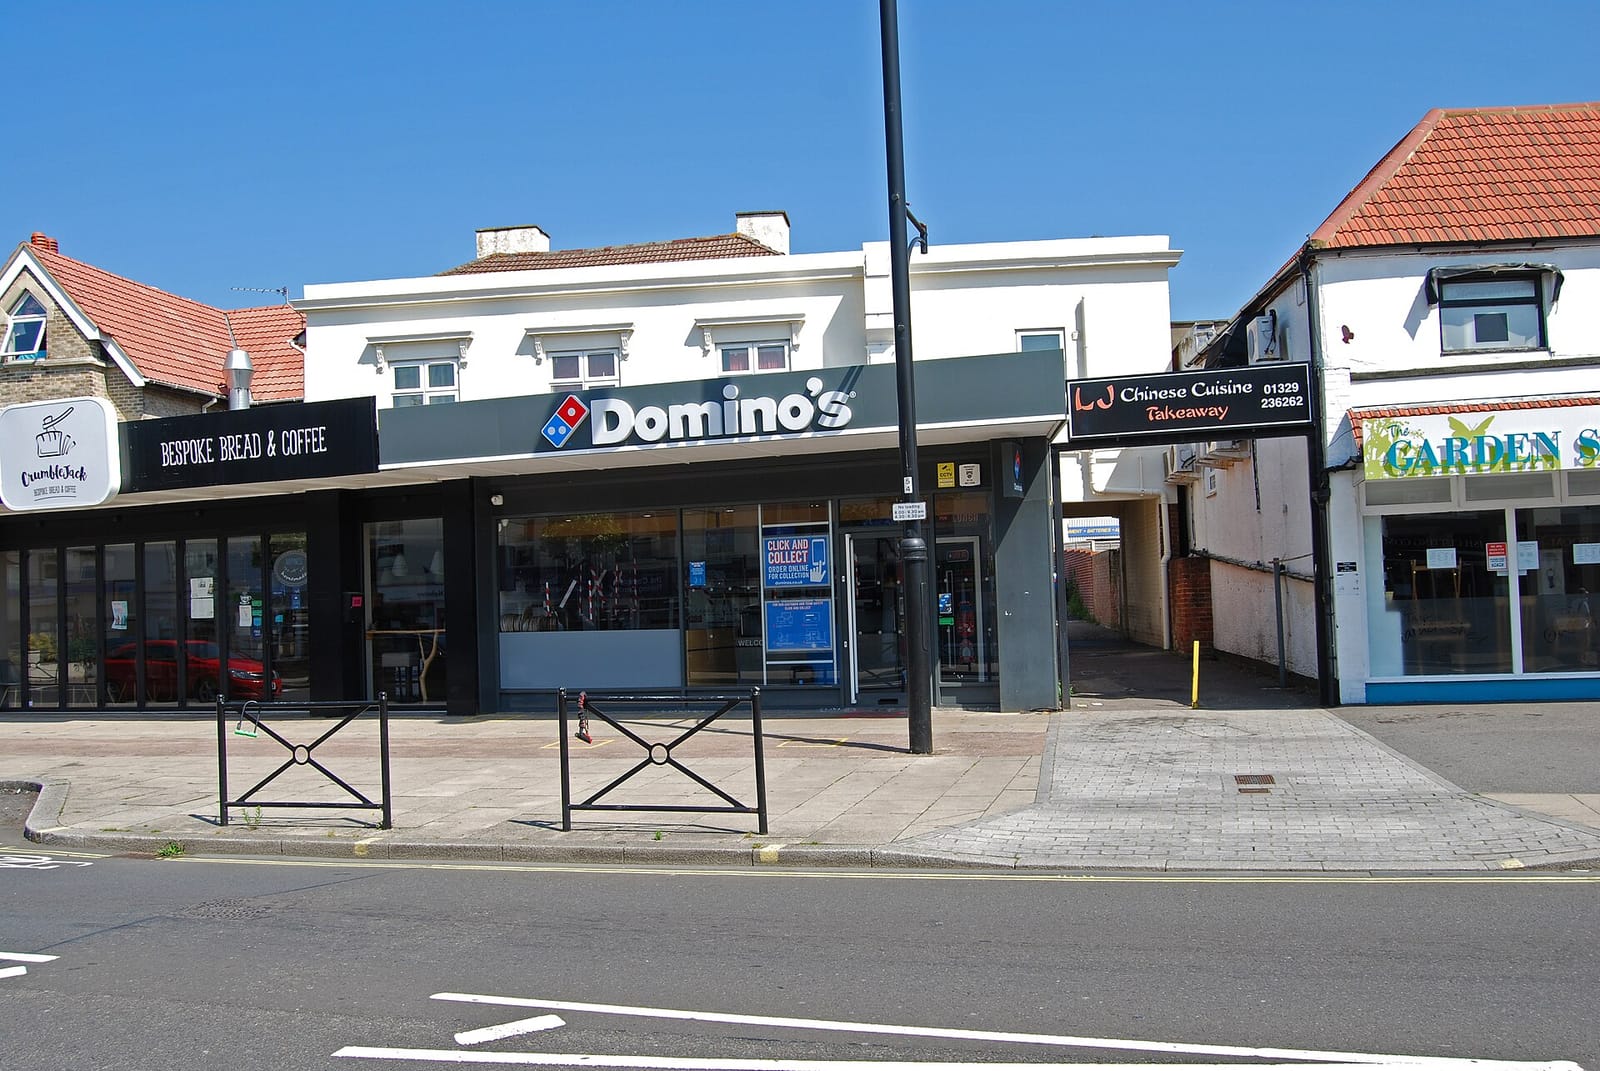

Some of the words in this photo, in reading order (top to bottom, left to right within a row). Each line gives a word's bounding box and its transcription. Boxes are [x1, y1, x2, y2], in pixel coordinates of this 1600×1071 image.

[1075, 384, 1115, 411] LJ
[1120, 386, 1187, 402] Chinese
[1191, 380, 1253, 398] Cuisine
[1263, 382, 1299, 395] 01329
[1261, 396, 1303, 409] 236262
[591, 377, 852, 445] Domino's
[1146, 405, 1229, 421] Takeaway
[1387, 424, 1410, 438] The
[160, 438, 215, 467] BESPOKE
[219, 432, 262, 461] BREAD
[266, 430, 277, 457] &
[281, 426, 328, 456] COFFEE
[1386, 431, 1562, 471] GARDEN
[22, 464, 88, 487] CrumbleJack
[767, 540, 790, 551] CLICK
[792, 539, 808, 550] AND
[768, 550, 808, 564] COLLECT
[768, 565, 787, 573] ORDER
[788, 564, 809, 572] ONLINE
[779, 572, 809, 580] COLLECTION
